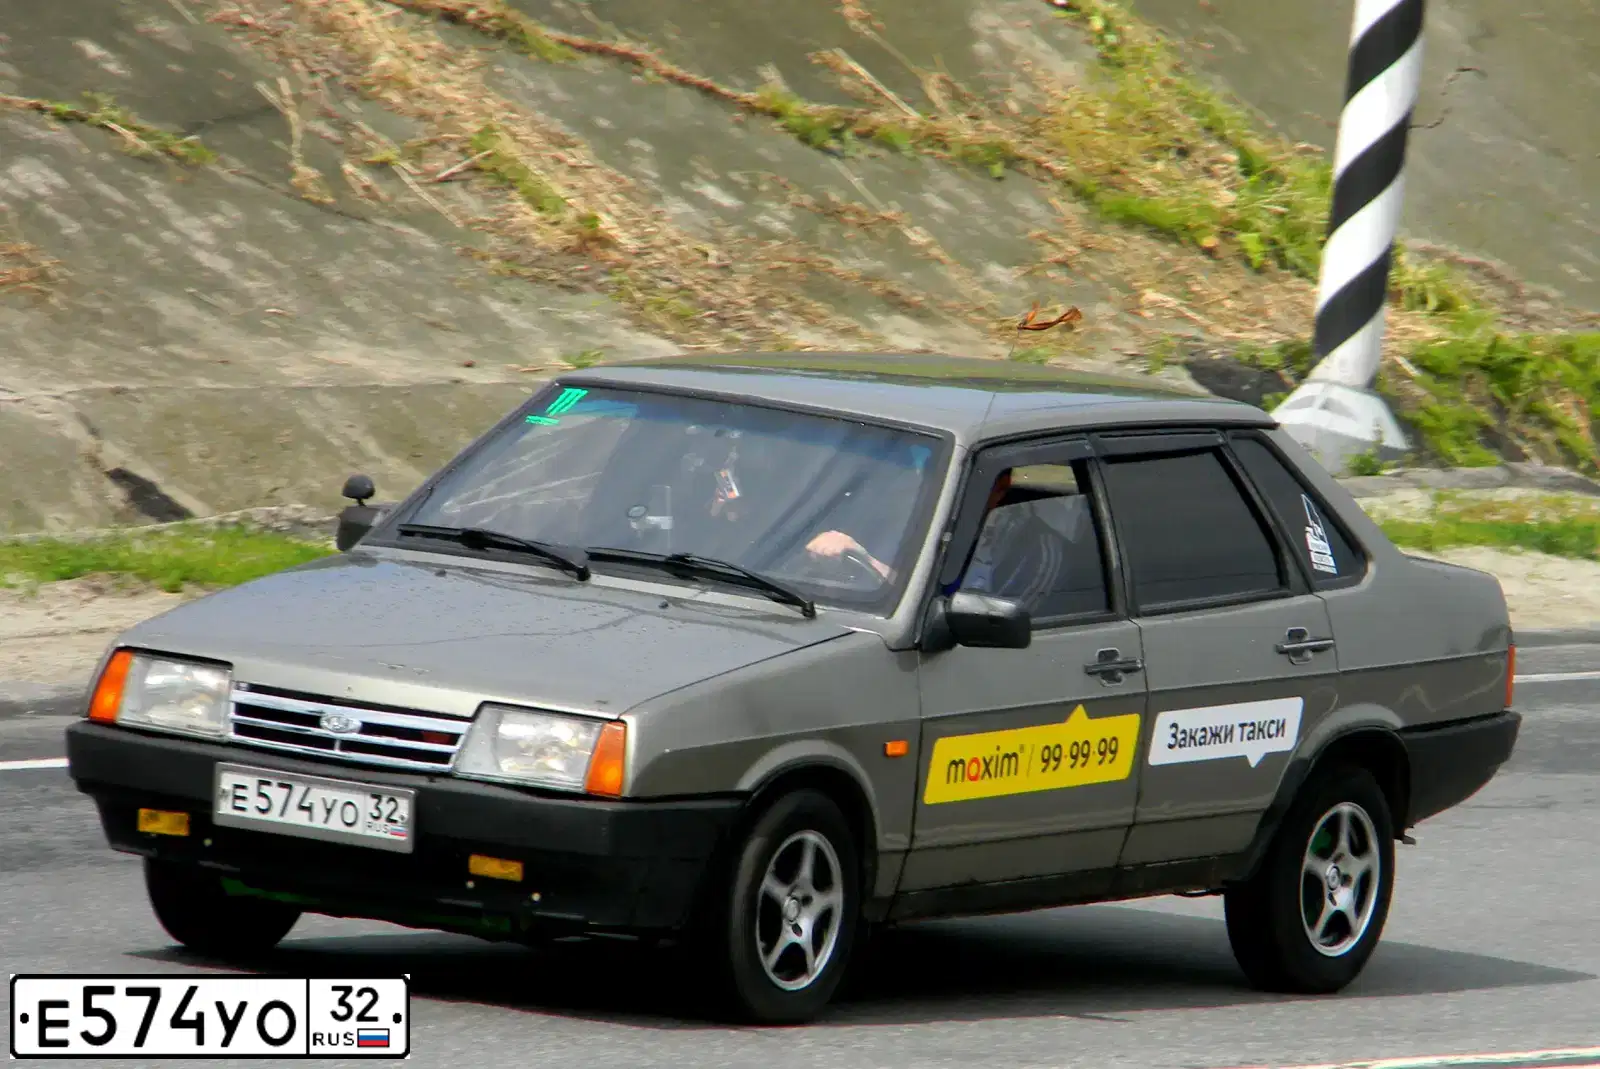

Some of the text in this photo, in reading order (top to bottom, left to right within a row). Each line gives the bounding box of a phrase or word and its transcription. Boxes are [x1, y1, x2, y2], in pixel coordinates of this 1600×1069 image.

[1167, 718, 1286, 750] Закажи такси
[369, 793, 399, 824] 32
[367, 821, 389, 834] RUS
